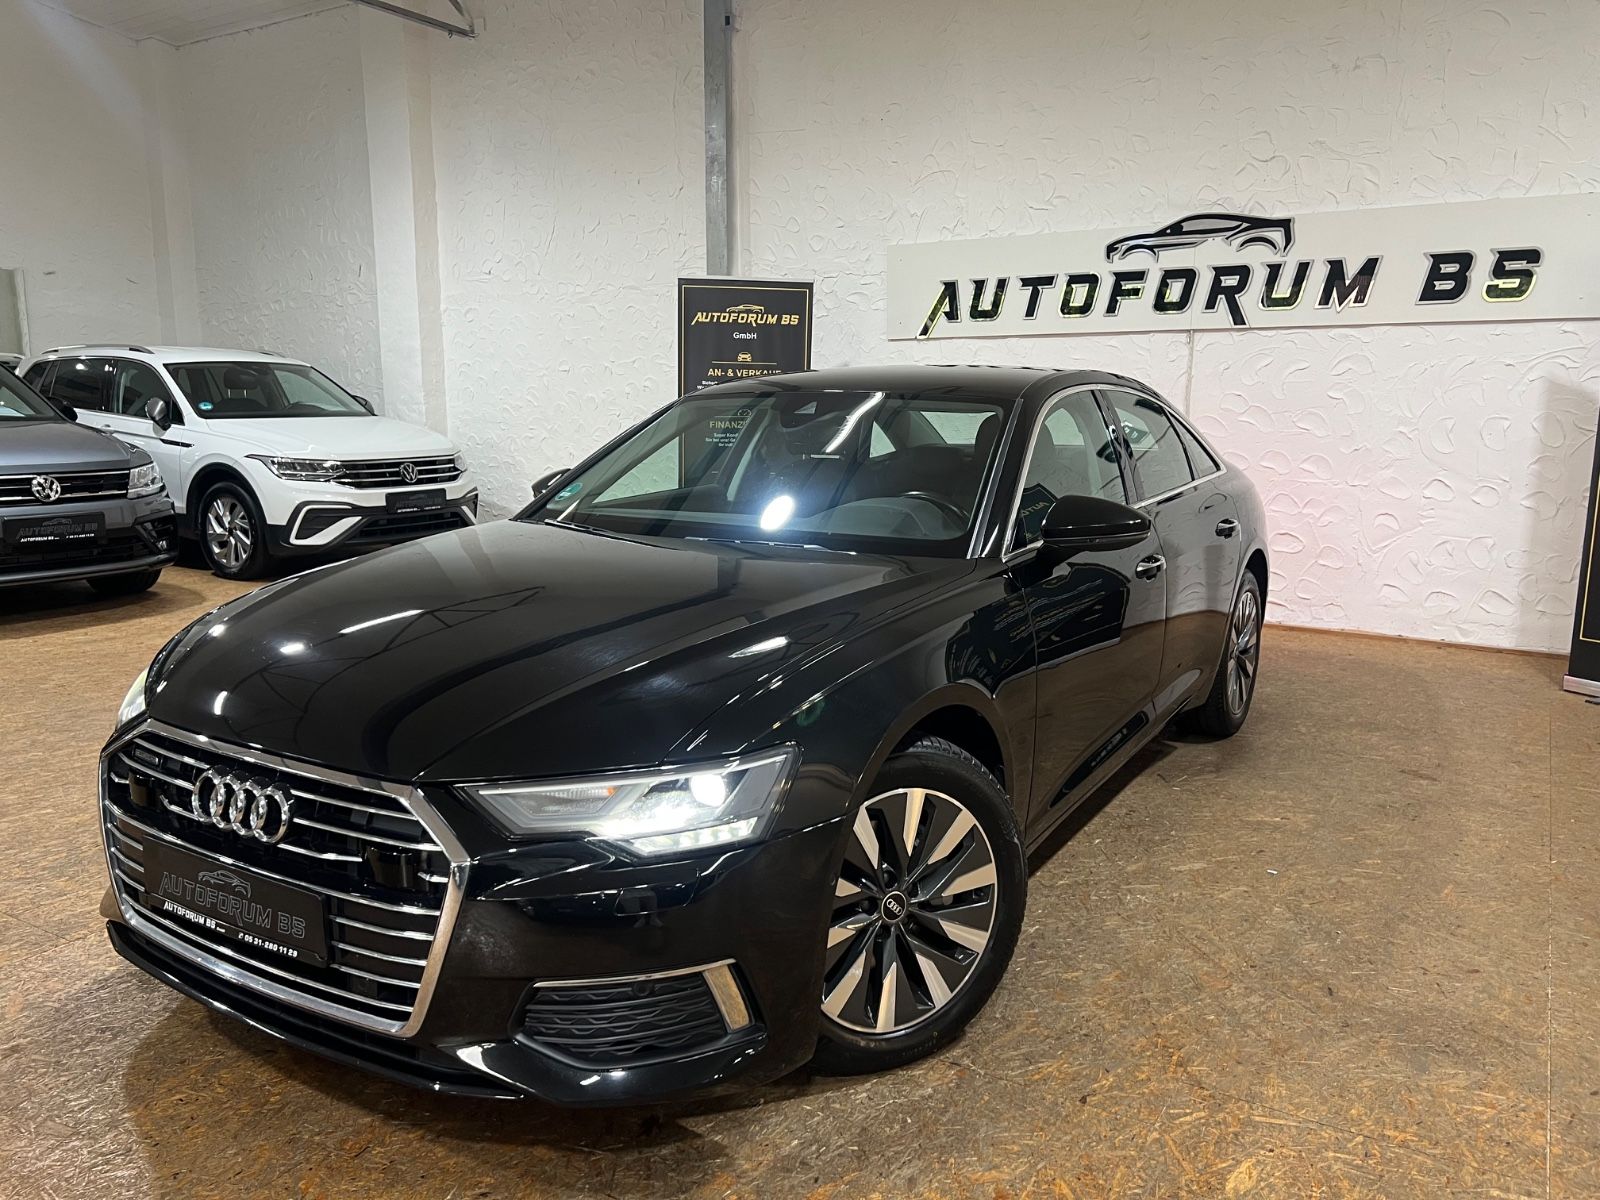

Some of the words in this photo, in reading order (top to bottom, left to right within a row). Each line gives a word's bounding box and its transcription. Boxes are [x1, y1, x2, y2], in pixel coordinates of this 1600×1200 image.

[916, 255, 1383, 340] AUTOFORUM
[1415, 246, 1546, 306] BS
[691, 312, 778, 327] AUTOFORUM
[780, 314, 799, 325] BS
[733, 332, 757, 340] GmbH
[707, 368, 725, 377] AN-
[727, 368, 734, 377] &
[158, 871, 273, 928] AUTOFORUM
[278, 911, 306, 939] BS
[163, 900, 205, 925] AUTOFORUM
[205, 918, 217, 929] BS
